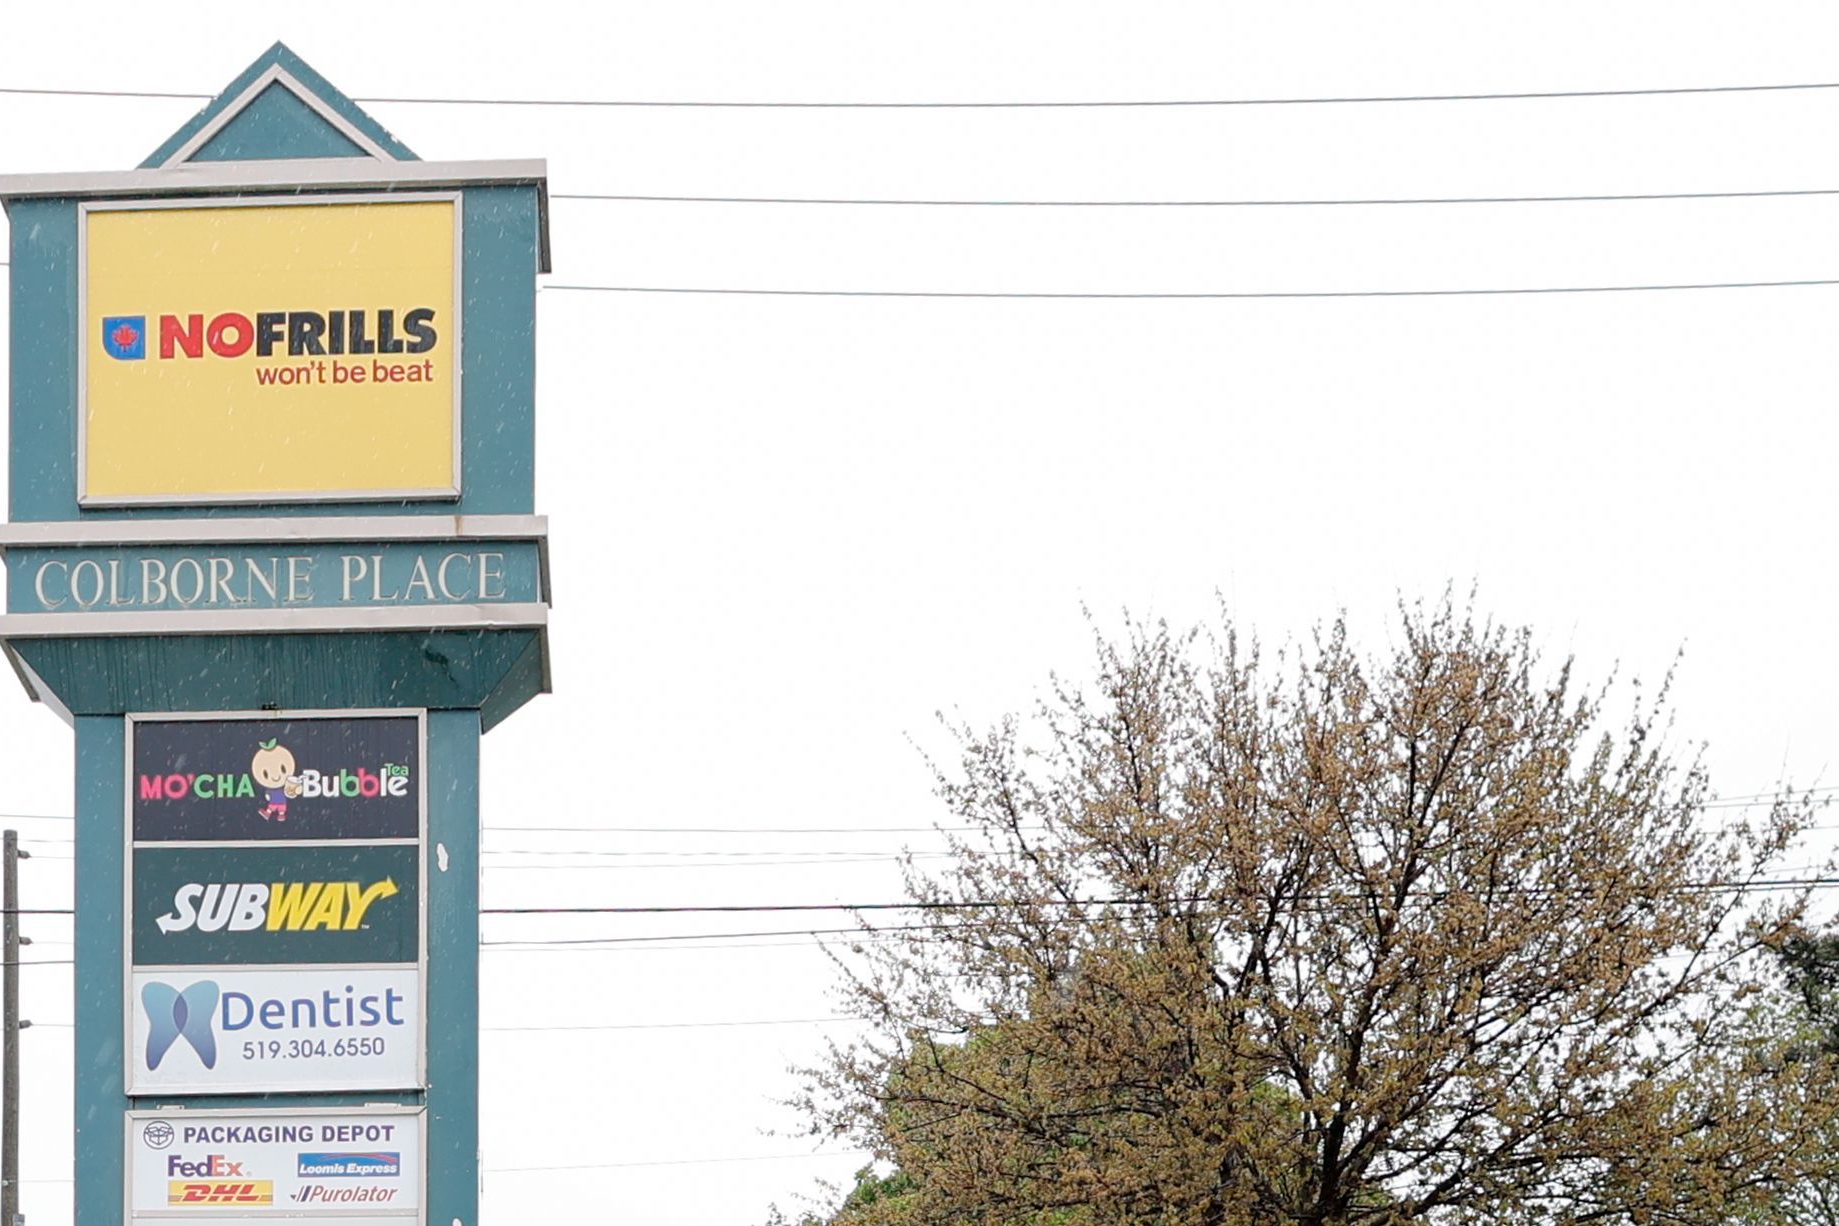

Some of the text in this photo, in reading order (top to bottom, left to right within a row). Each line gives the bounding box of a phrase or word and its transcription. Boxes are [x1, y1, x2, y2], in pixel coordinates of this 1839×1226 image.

[256, 358, 433, 385] won't be beat
[34, 552, 508, 607] COLBORNE PLACE
[140, 763, 410, 800] MO'CHA Bubble Tea
[155, 875, 400, 934] SUBWAY
[222, 985, 404, 1030] Dentist
[242, 1037, 385, 1060] 519.304.6550
[183, 1125, 395, 1144] PACKAGING DEPOT
[168, 1154, 243, 1177] FedEx
[299, 1162, 397, 1176] Loomis Express
[182, 1184, 260, 1202] DHL
[309, 1185, 398, 1203] Purolator
